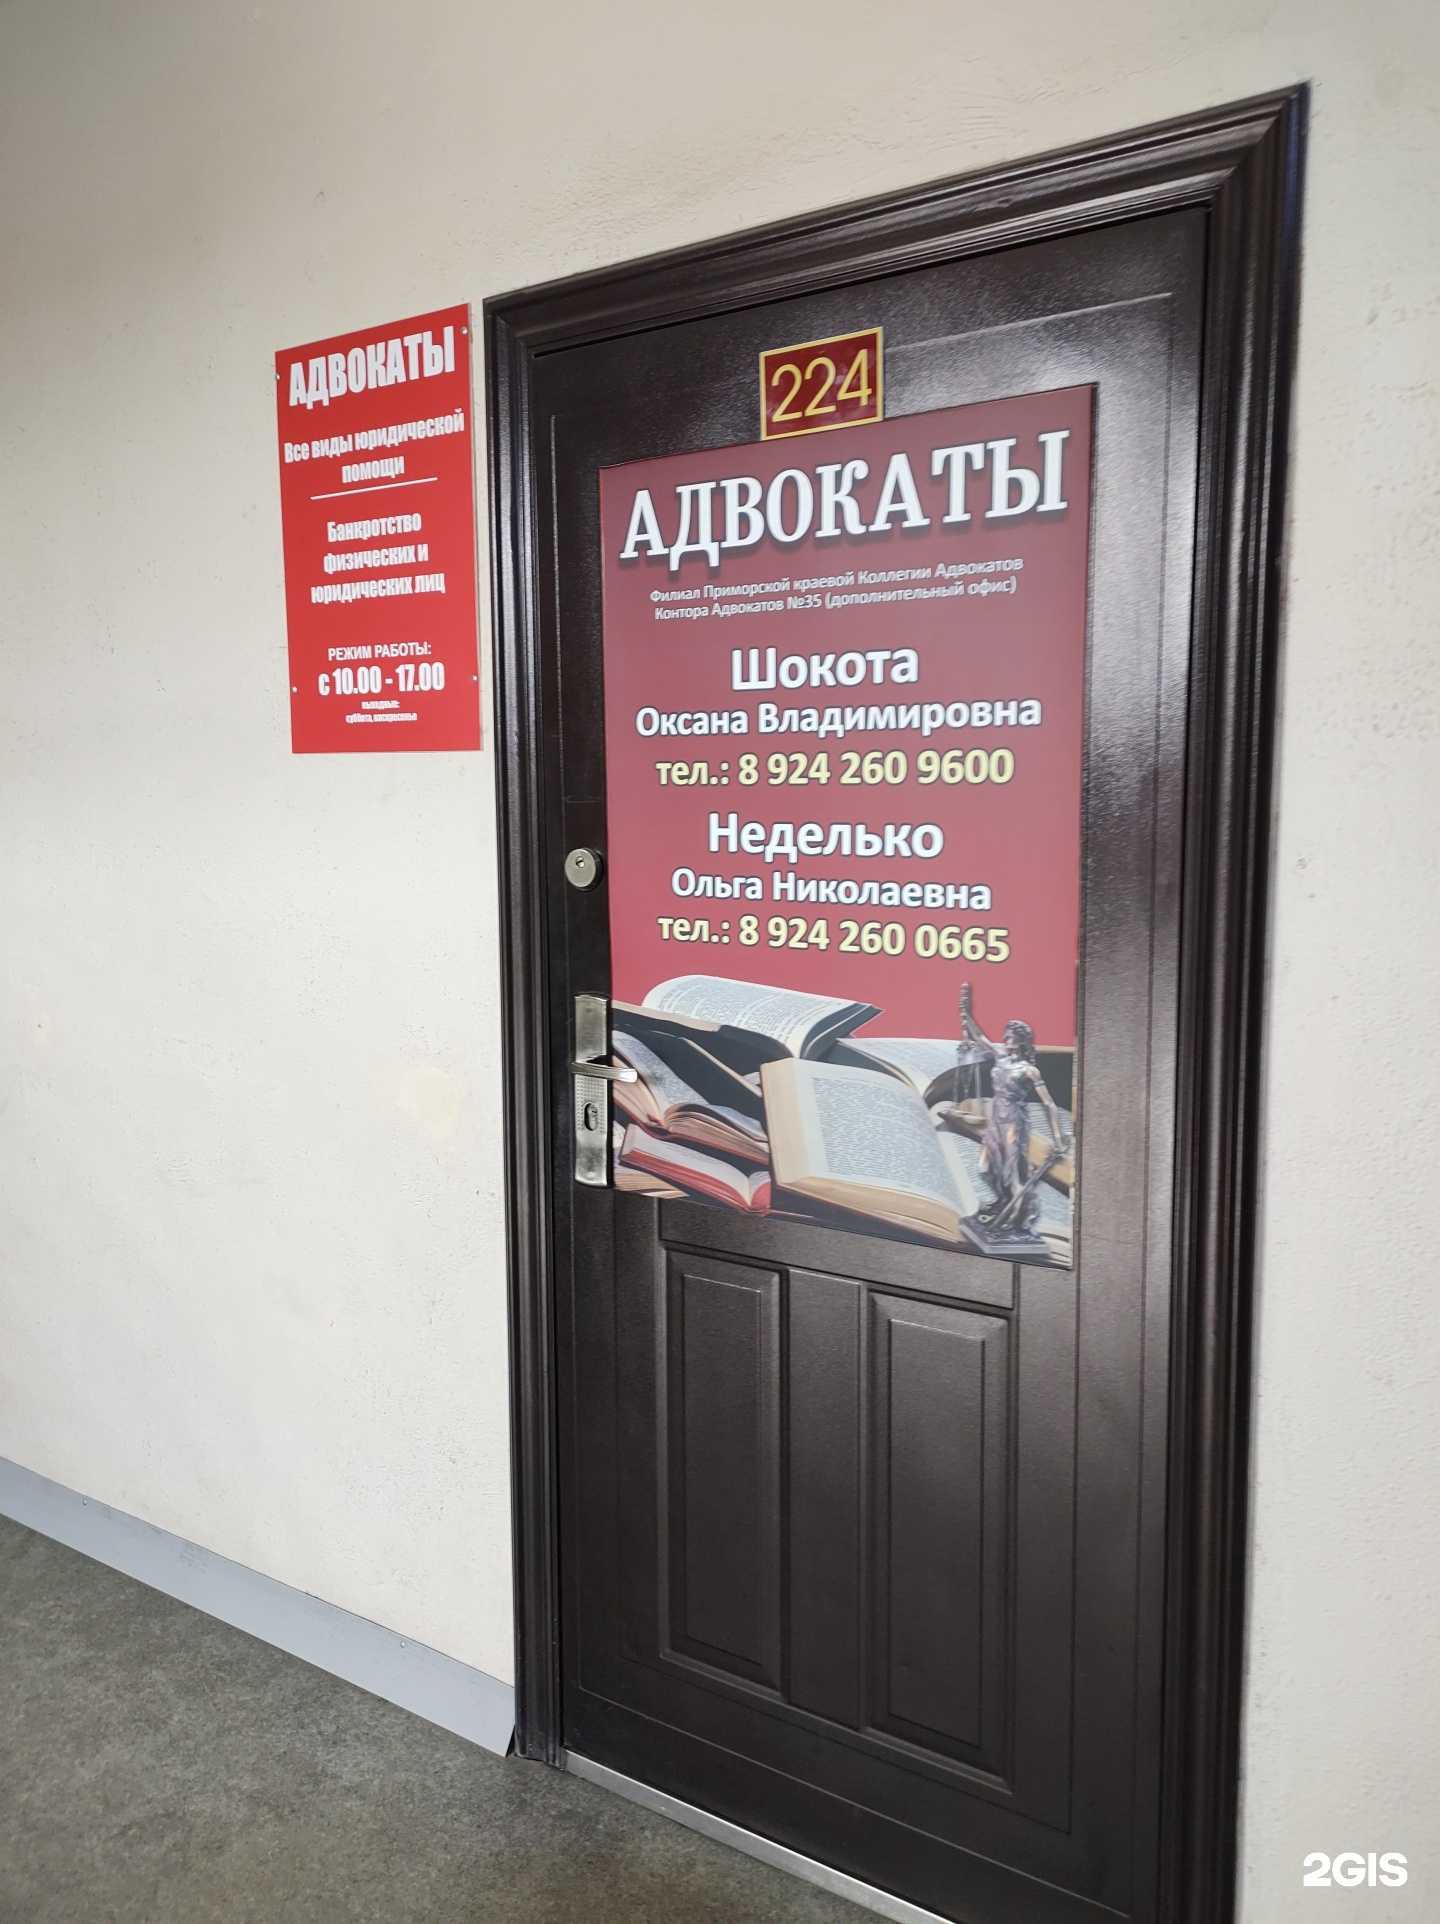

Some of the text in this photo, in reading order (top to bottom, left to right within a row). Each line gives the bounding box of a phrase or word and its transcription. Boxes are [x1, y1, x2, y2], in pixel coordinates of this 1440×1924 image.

[289, 325, 455, 410] АДВОКАТЫ
[770, 348, 873, 424] 224
[284, 408, 465, 463] Все виды юридической
[341, 456, 405, 483] помощи
[619, 430, 1071, 571] АДВОКАТЫ
[327, 513, 422, 543] Банкротство
[417, 543, 429, 562] и
[311, 573, 446, 604] юридических лиц
[650, 558, 1025, 603] Филиал Приморской краевой Коллегии Адвокатов
[655, 575, 1018, 621] Контора Адвокатов №35 (дополнительный офис)
[328, 641, 432, 662] РЕЖИМ РАБОТЫ:
[730, 646, 920, 691] Шокота
[332, 665, 382, 695] 10.00
[395, 662, 445, 693] 17.00
[635, 698, 1042, 738] Оксана Владимировна
[655, 748, 1016, 786] тел.: 8 924 260 9600
[707, 812, 945, 863] Неделько
[671, 867, 992, 911] Ольга Николаевна
[657, 914, 1011, 963] тел.: 8 924 260 0665
